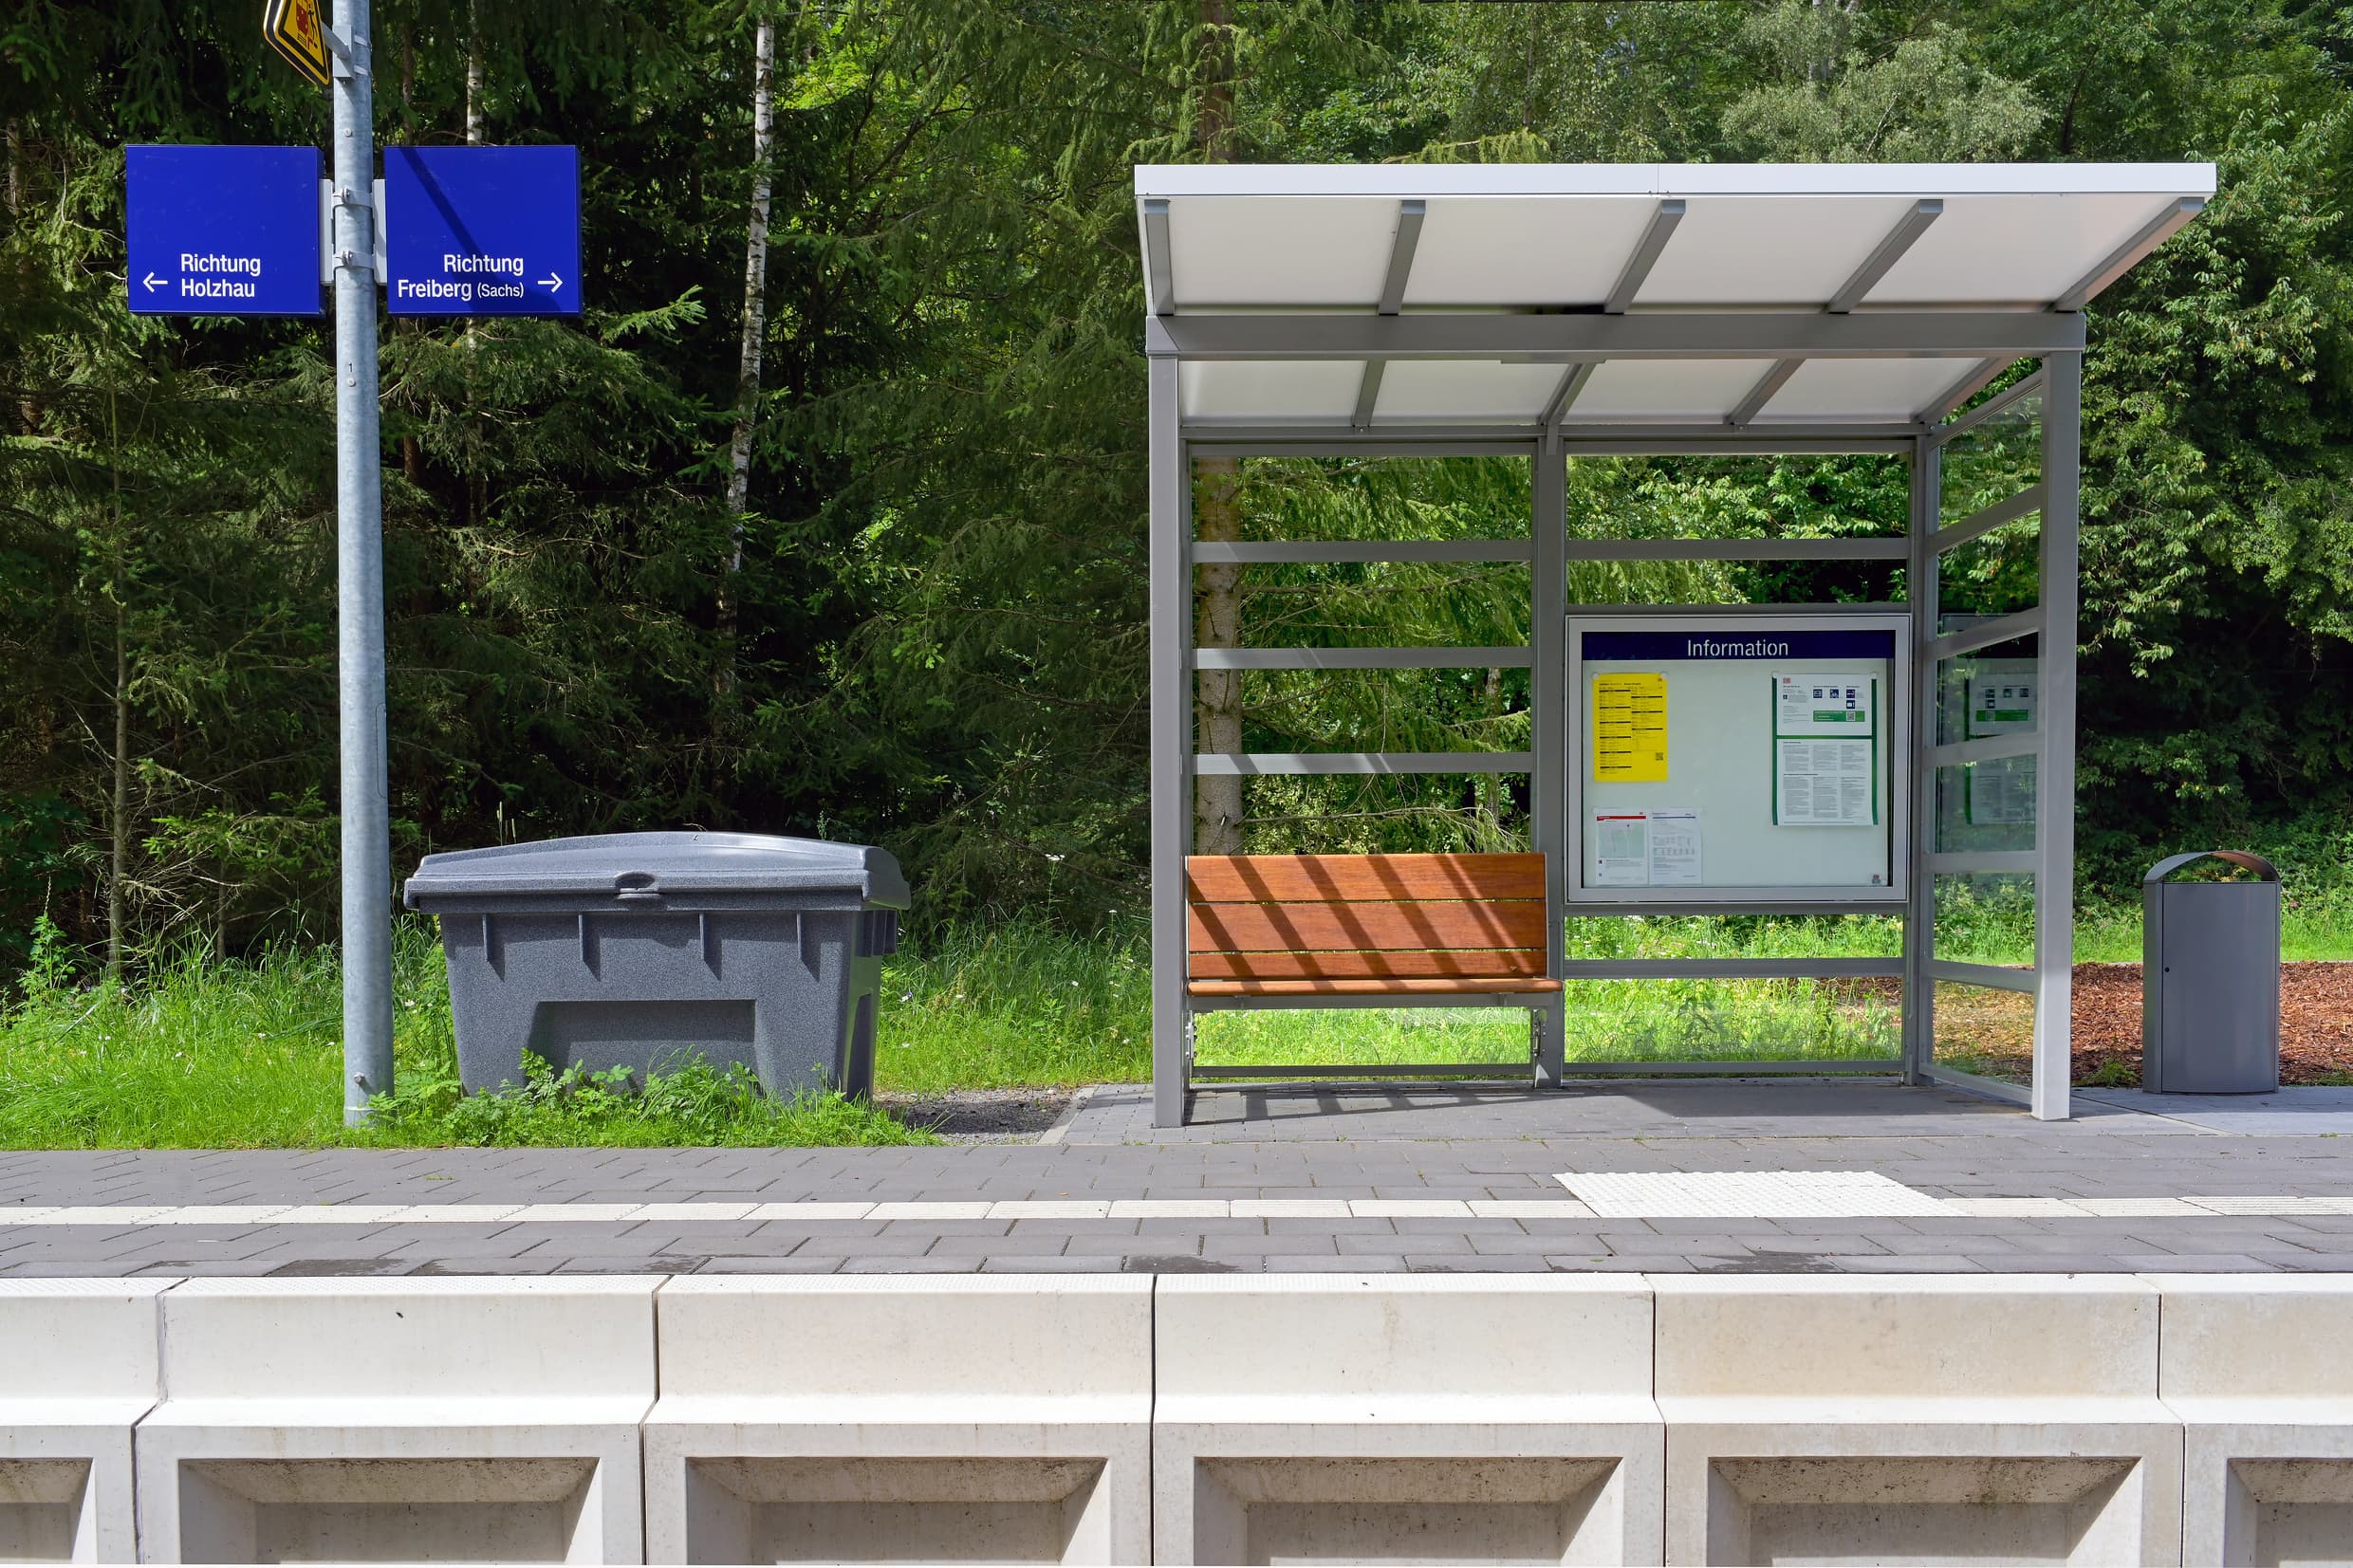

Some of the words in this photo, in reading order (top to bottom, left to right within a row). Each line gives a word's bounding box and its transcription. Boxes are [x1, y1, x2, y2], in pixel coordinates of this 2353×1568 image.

[180, 252, 261, 277] Richtung
[443, 253, 525, 277] Richtung
[181, 278, 255, 298] Holzhau
[398, 278, 472, 302] Freiberg
[477, 281, 525, 299] (Sachs)
[1687, 638, 1789, 657] Information
